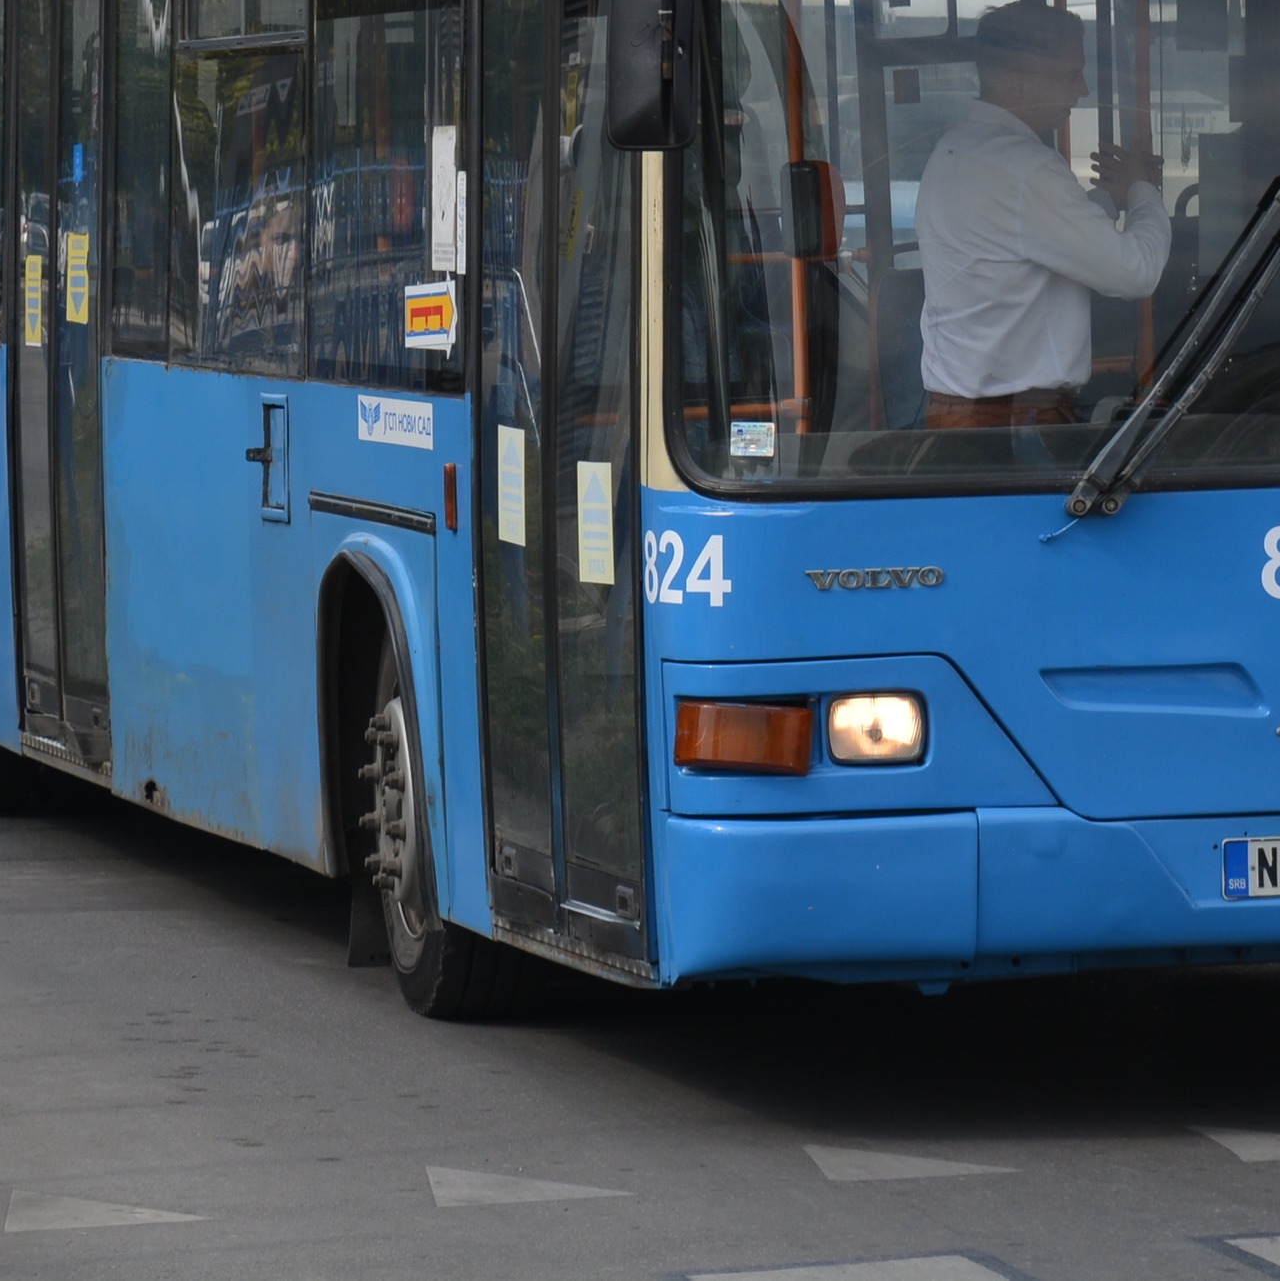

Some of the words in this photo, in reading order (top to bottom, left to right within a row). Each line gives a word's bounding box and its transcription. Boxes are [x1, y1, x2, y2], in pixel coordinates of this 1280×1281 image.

[644, 529, 732, 607] 824
[804, 565, 946, 591] VOLVO
[1228, 877, 1247, 891] SRB
